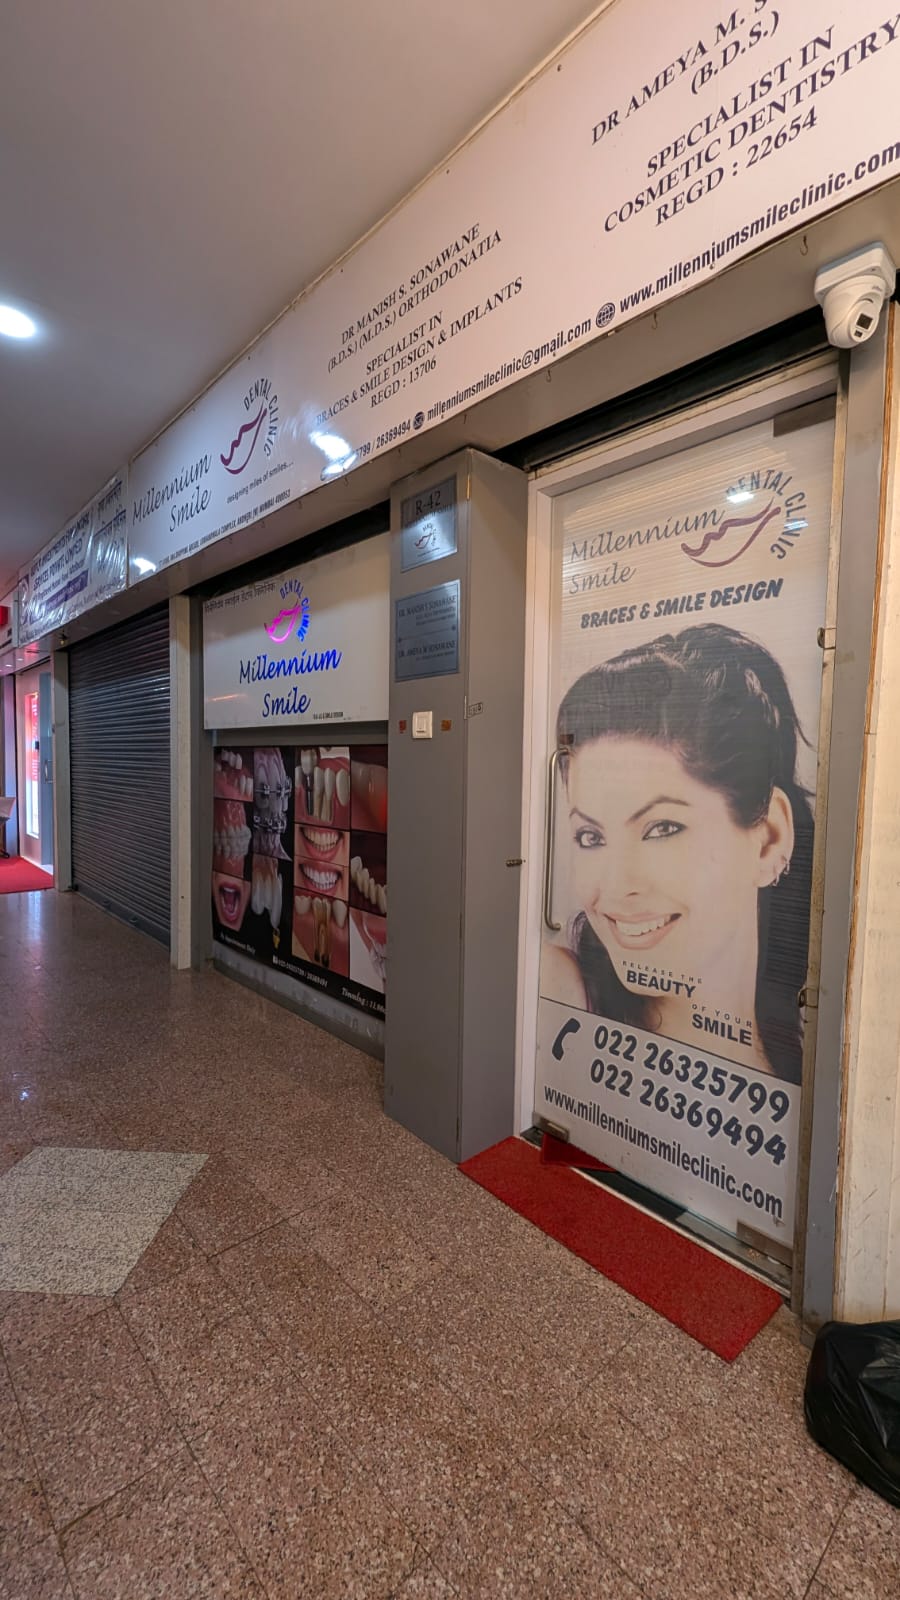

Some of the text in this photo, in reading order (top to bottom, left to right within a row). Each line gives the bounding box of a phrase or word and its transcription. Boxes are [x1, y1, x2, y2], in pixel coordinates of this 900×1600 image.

[592, 9, 746, 146] DR AMEYA M.
[691, 11, 779, 95] (B.D.S.)
[604, 14, 900, 233] COSMETIC DENTISTRY
[647, 24, 835, 178] SPECIALIST IN
[655, 166, 725, 227] REGD
[746, 105, 818, 168] 22654
[619, 142, 900, 313] www.millenniumsmileclinic.com
[341, 223, 480, 346] DR MANISH S. SONAWANE
[359, 311, 397, 350] (M.D.S.)
[399, 230, 502, 317] ORTHODONATIA
[316, 276, 523, 427] BRACES & SMILE DESIGN & IMPLANTS
[366, 311, 443, 376] SPECIALIST IN
[427, 316, 592, 421] millenniumsmileclinic@gmail.com
[243, 378, 279, 456] DENTAL CLINIC
[370, 379, 401, 409] REGD
[409, 356, 437, 384] 13706
[376, 418, 411, 449] 26369494
[133, 453, 212, 525] Millennium
[169, 486, 212, 532] Smile
[416, 490, 441, 515] R-42
[570, 507, 725, 563] Millennium
[769, 491, 808, 560] CLINIC
[280, 578, 304, 600] DENTAL
[568, 561, 637, 595] Smile
[580, 578, 785, 630] BRACES & SMILE DESIGN
[239, 649, 343, 684] Millennium
[262, 686, 312, 718] Smile
[622, 961, 703, 985] RELEASE THE
[626, 969, 697, 999] BEAUTY
[691, 1003, 753, 1029] OF YOUR
[692, 1013, 753, 1047] SMILE
[594, 1024, 790, 1123] 022 26325799
[590, 1058, 788, 1166] 022 26369494
[544, 1085, 783, 1219] www.millenniumsmileclinic.com
